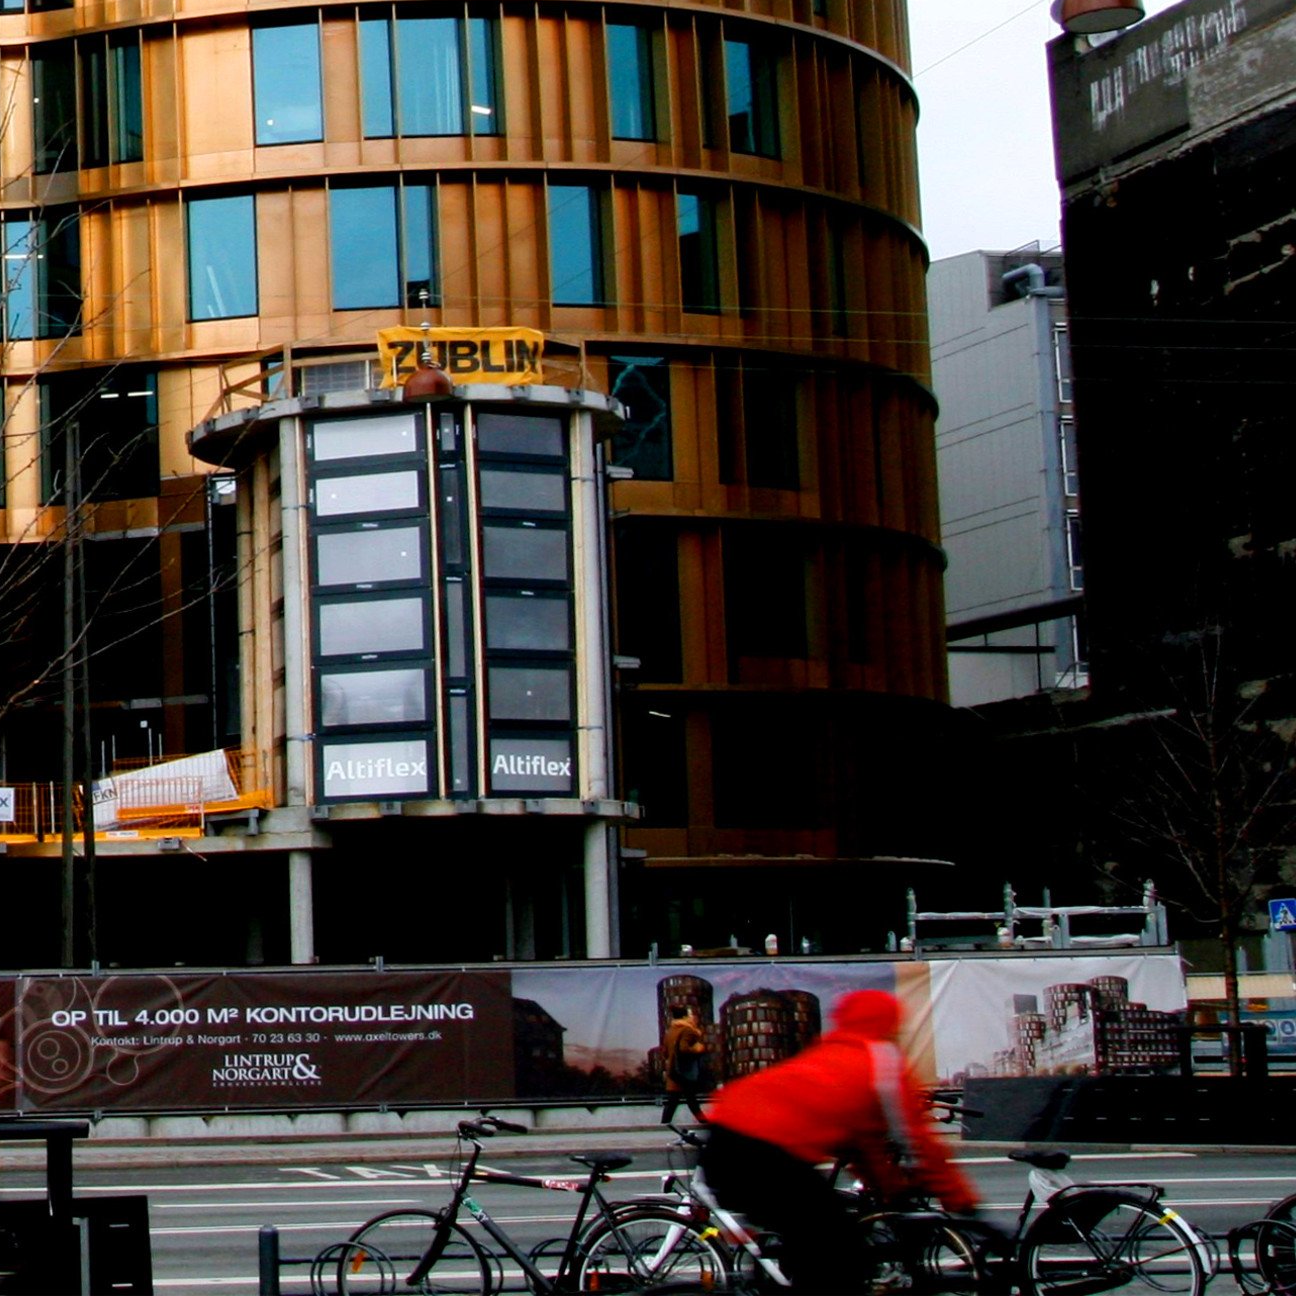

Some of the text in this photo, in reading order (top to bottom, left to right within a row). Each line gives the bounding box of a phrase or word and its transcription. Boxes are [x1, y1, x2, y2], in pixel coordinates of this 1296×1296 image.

[327, 757, 426, 781] Altiflex
[493, 754, 571, 776] Altiflex
[93, 787, 117, 802] FKN
[51, 1003, 474, 1027] OP TIL 4.000 M² KONTORUDLEJNING
[91, 1031, 442, 1047] Kontakt: Lintrup & Norgart 70 23 63 30 www.axeltowers.dk
[212, 1067, 292, 1081] NORGART
[224, 1053, 321, 1079] LINTRUP &
